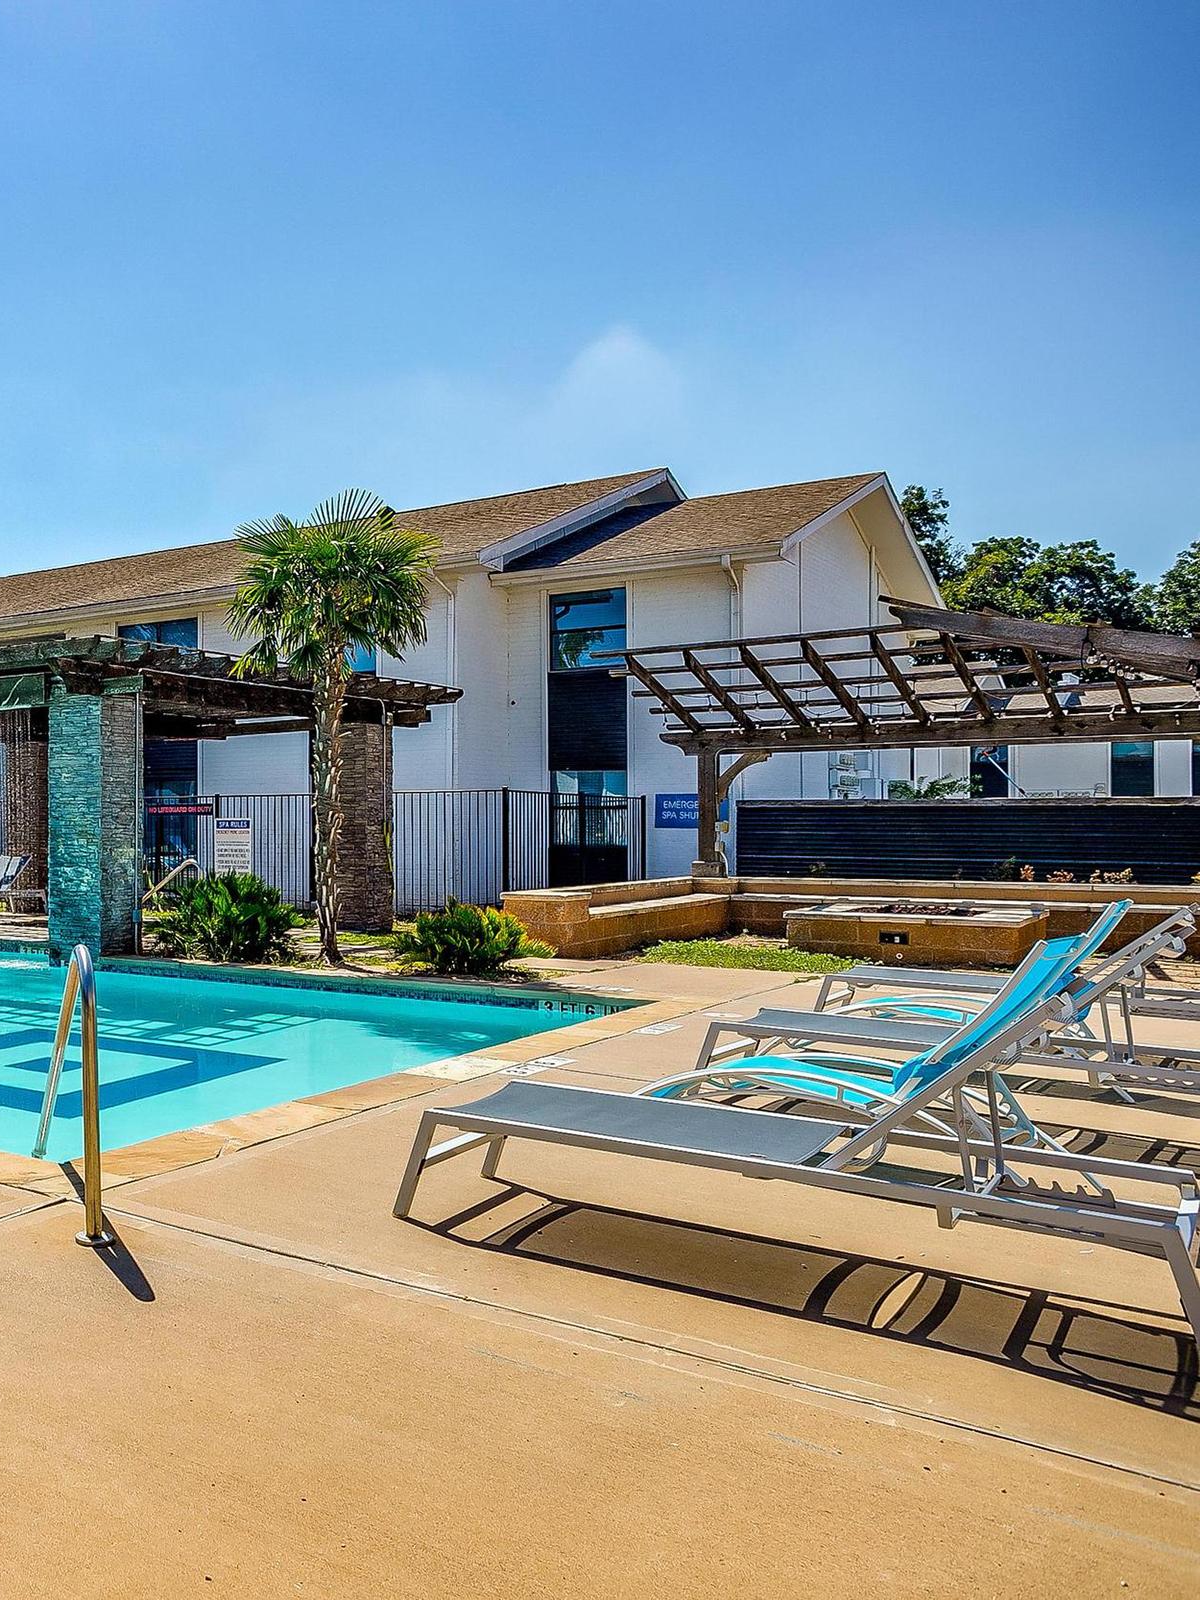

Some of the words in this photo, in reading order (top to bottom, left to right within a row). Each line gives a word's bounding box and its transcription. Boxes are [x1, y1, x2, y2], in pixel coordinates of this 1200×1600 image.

[198, 805, 212, 813] DUTY
[662, 811, 677, 819] SPA
[544, 1001, 553, 1011] 3
[561, 1002, 577, 1013] FT
[585, 1004, 595, 1015] 6
[604, 1005, 620, 1016] IN
